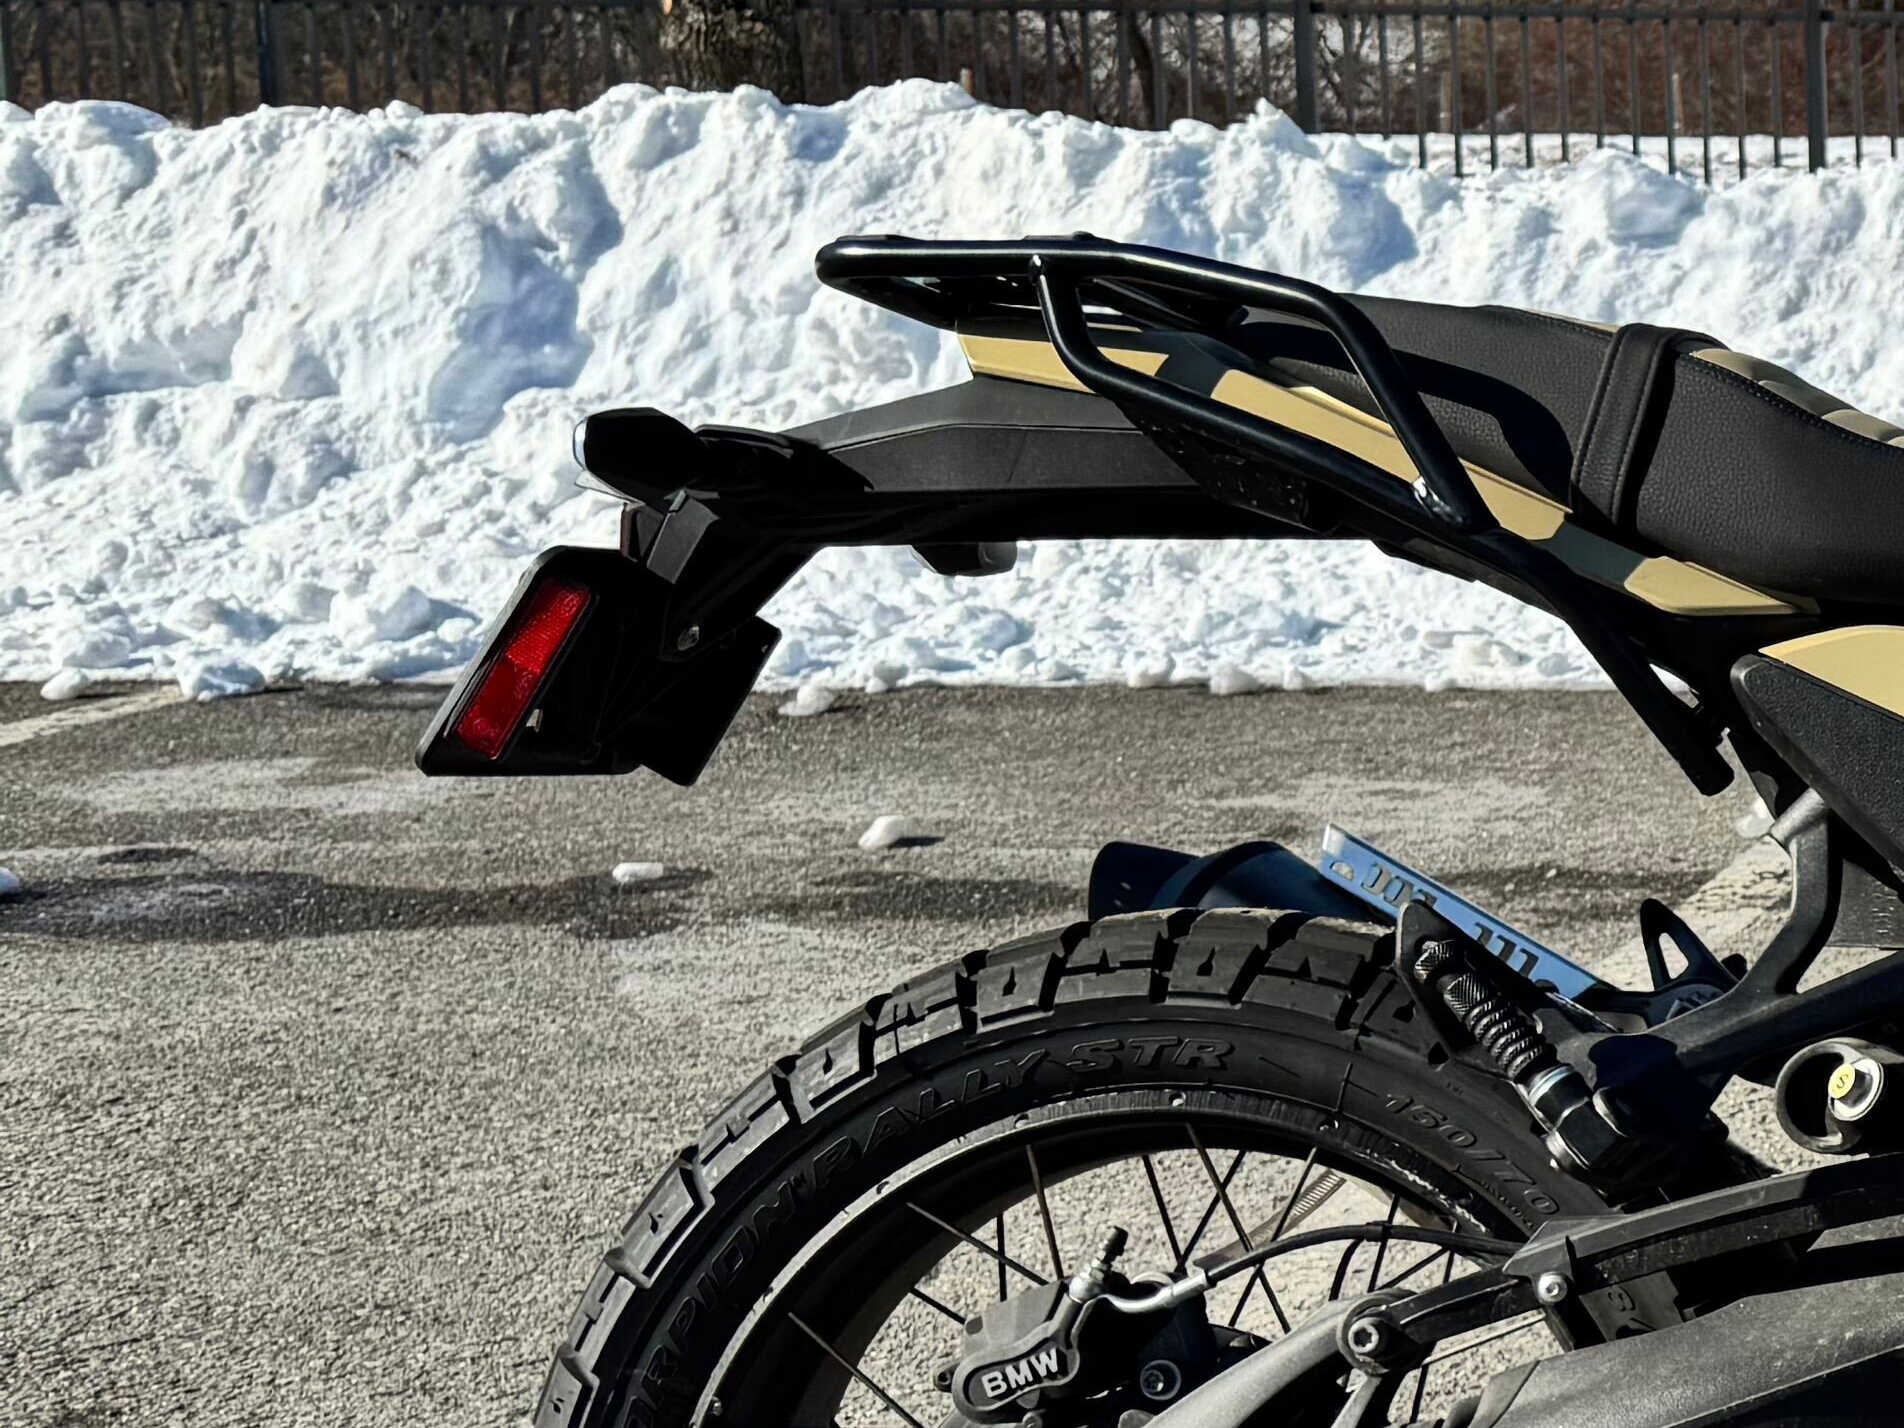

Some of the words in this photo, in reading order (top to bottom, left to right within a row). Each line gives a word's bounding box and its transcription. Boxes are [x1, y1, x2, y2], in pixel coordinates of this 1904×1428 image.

[803, 1049, 1046, 1190] RALLY
[1069, 1035, 1233, 1072] STR
[981, 1347, 1059, 1398] BMW
